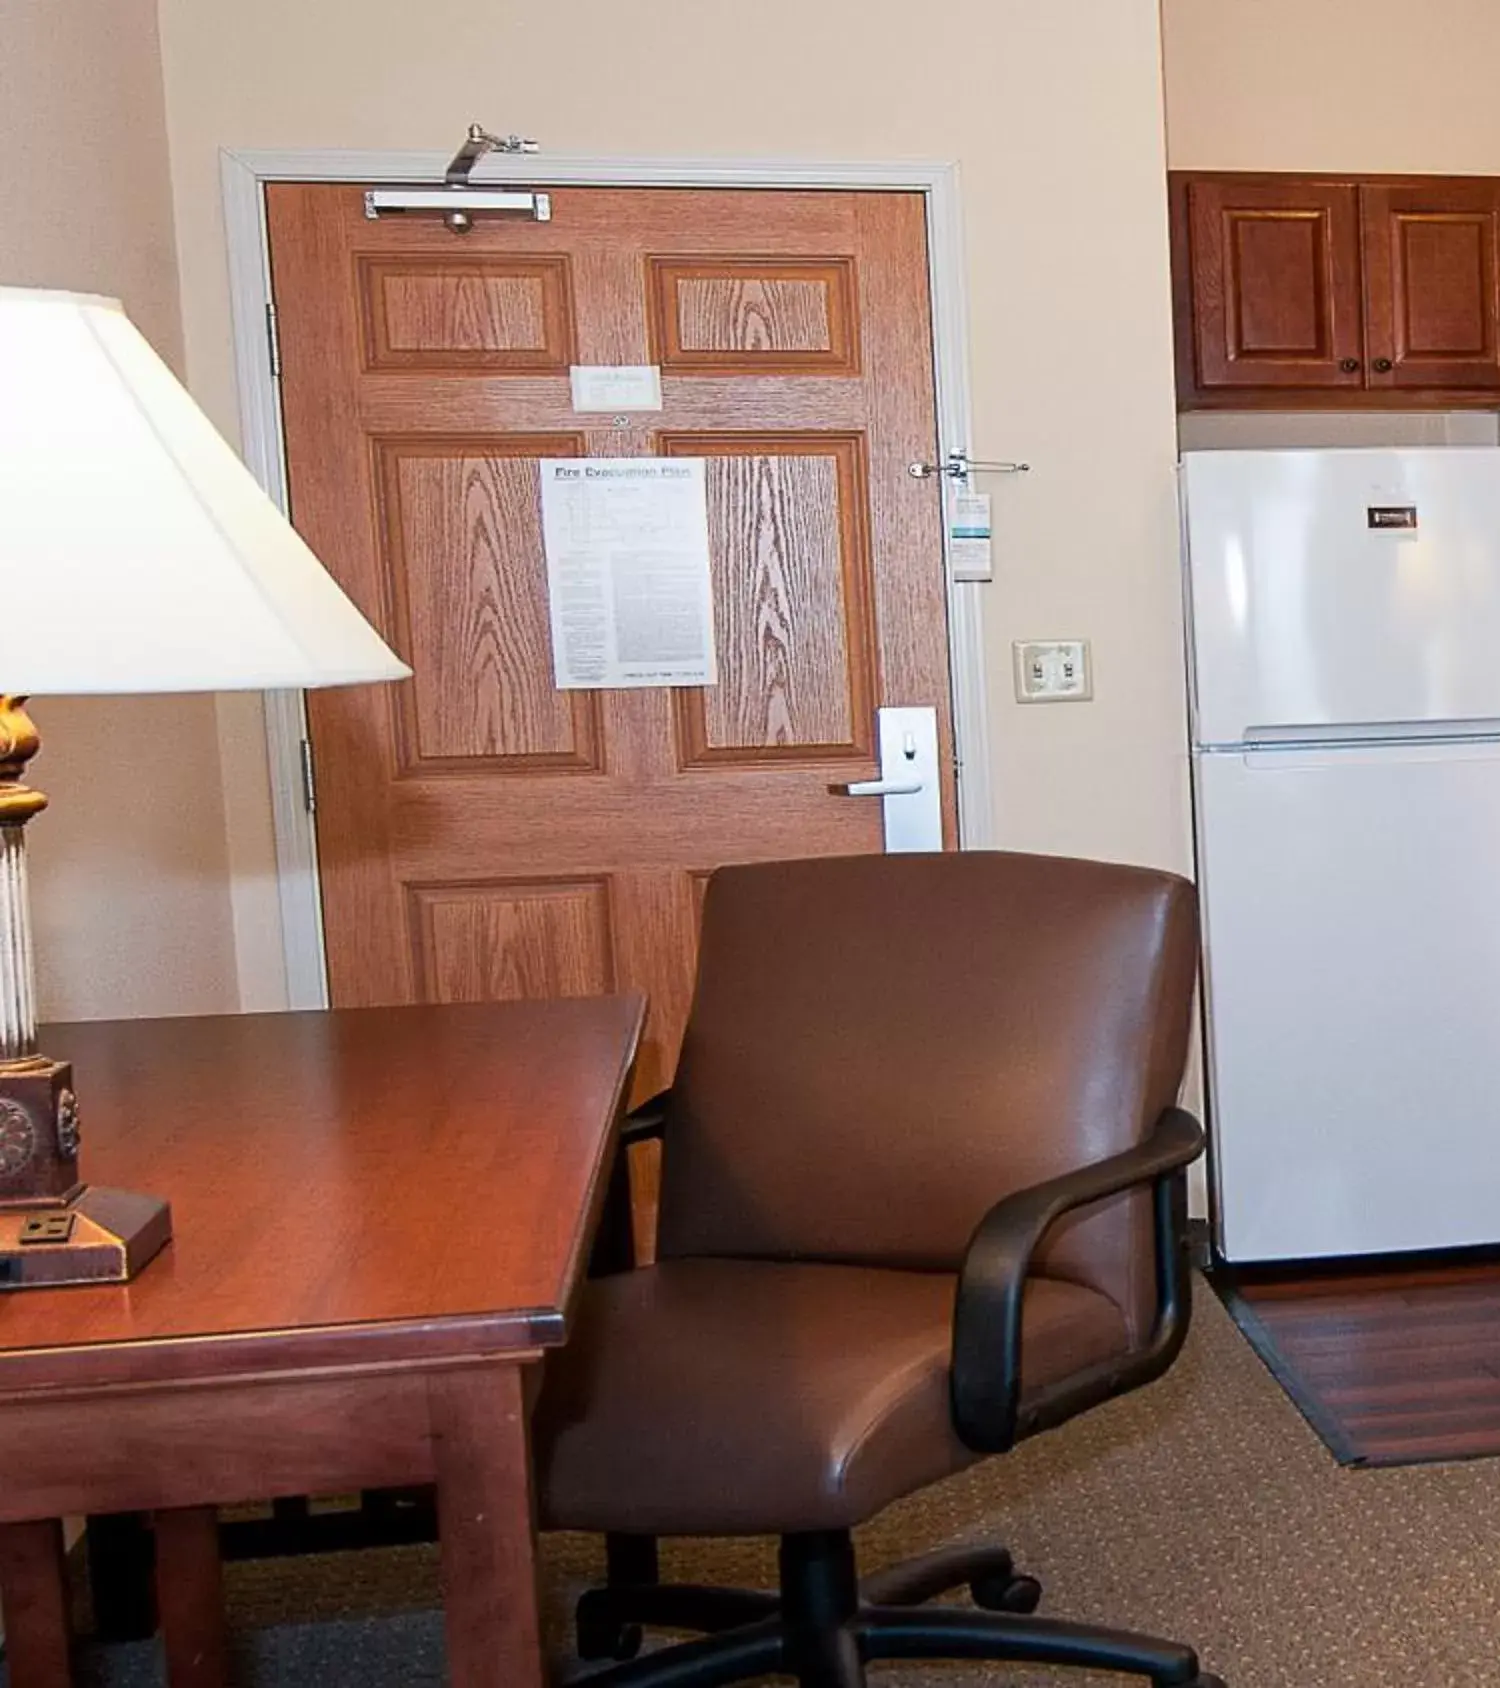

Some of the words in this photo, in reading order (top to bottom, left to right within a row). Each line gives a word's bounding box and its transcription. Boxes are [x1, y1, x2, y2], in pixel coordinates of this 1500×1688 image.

[555, 467, 580, 477] Fire
[585, 466, 656, 477] Evacuation
[661, 466, 691, 477] Plan
